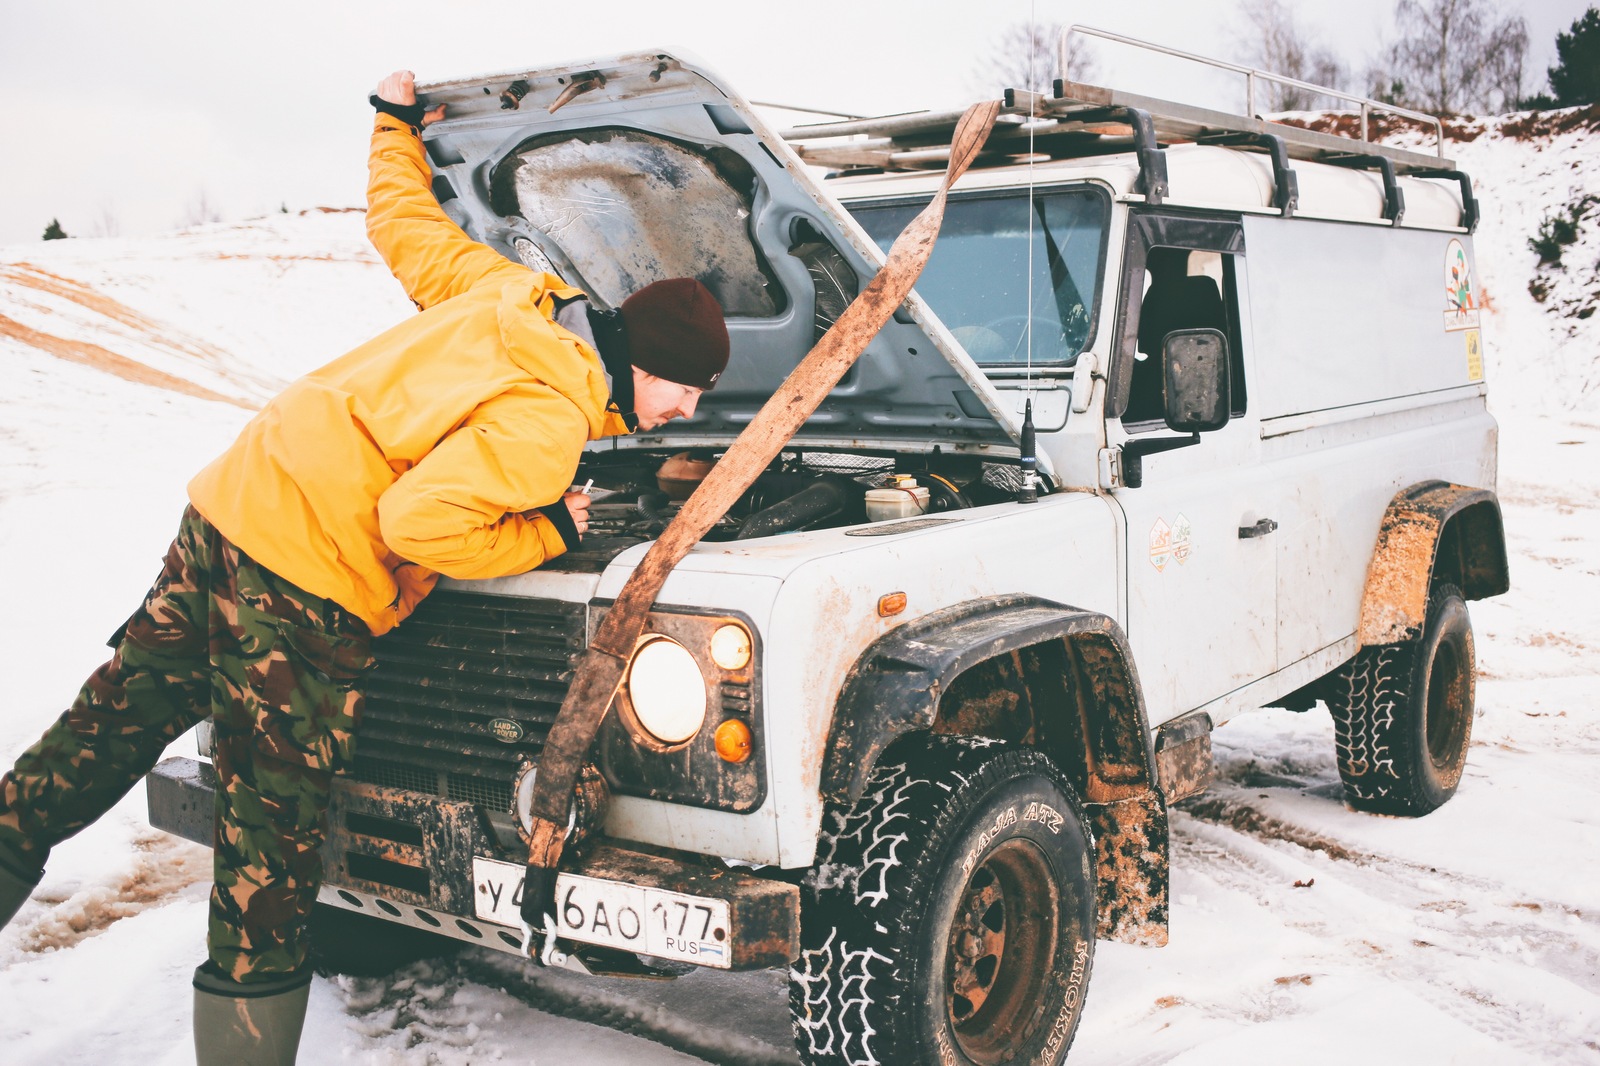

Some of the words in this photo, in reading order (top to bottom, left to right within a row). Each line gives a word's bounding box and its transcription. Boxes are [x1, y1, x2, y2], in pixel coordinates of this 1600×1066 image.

[494, 721, 512, 730] LAND
[496, 729, 518, 738] ROVER
[962, 806, 1018, 877] BAJA
[652, 902, 712, 940] 177
[666, 937, 698, 955] RUS
[1041, 940, 1089, 1066] MICKEY
